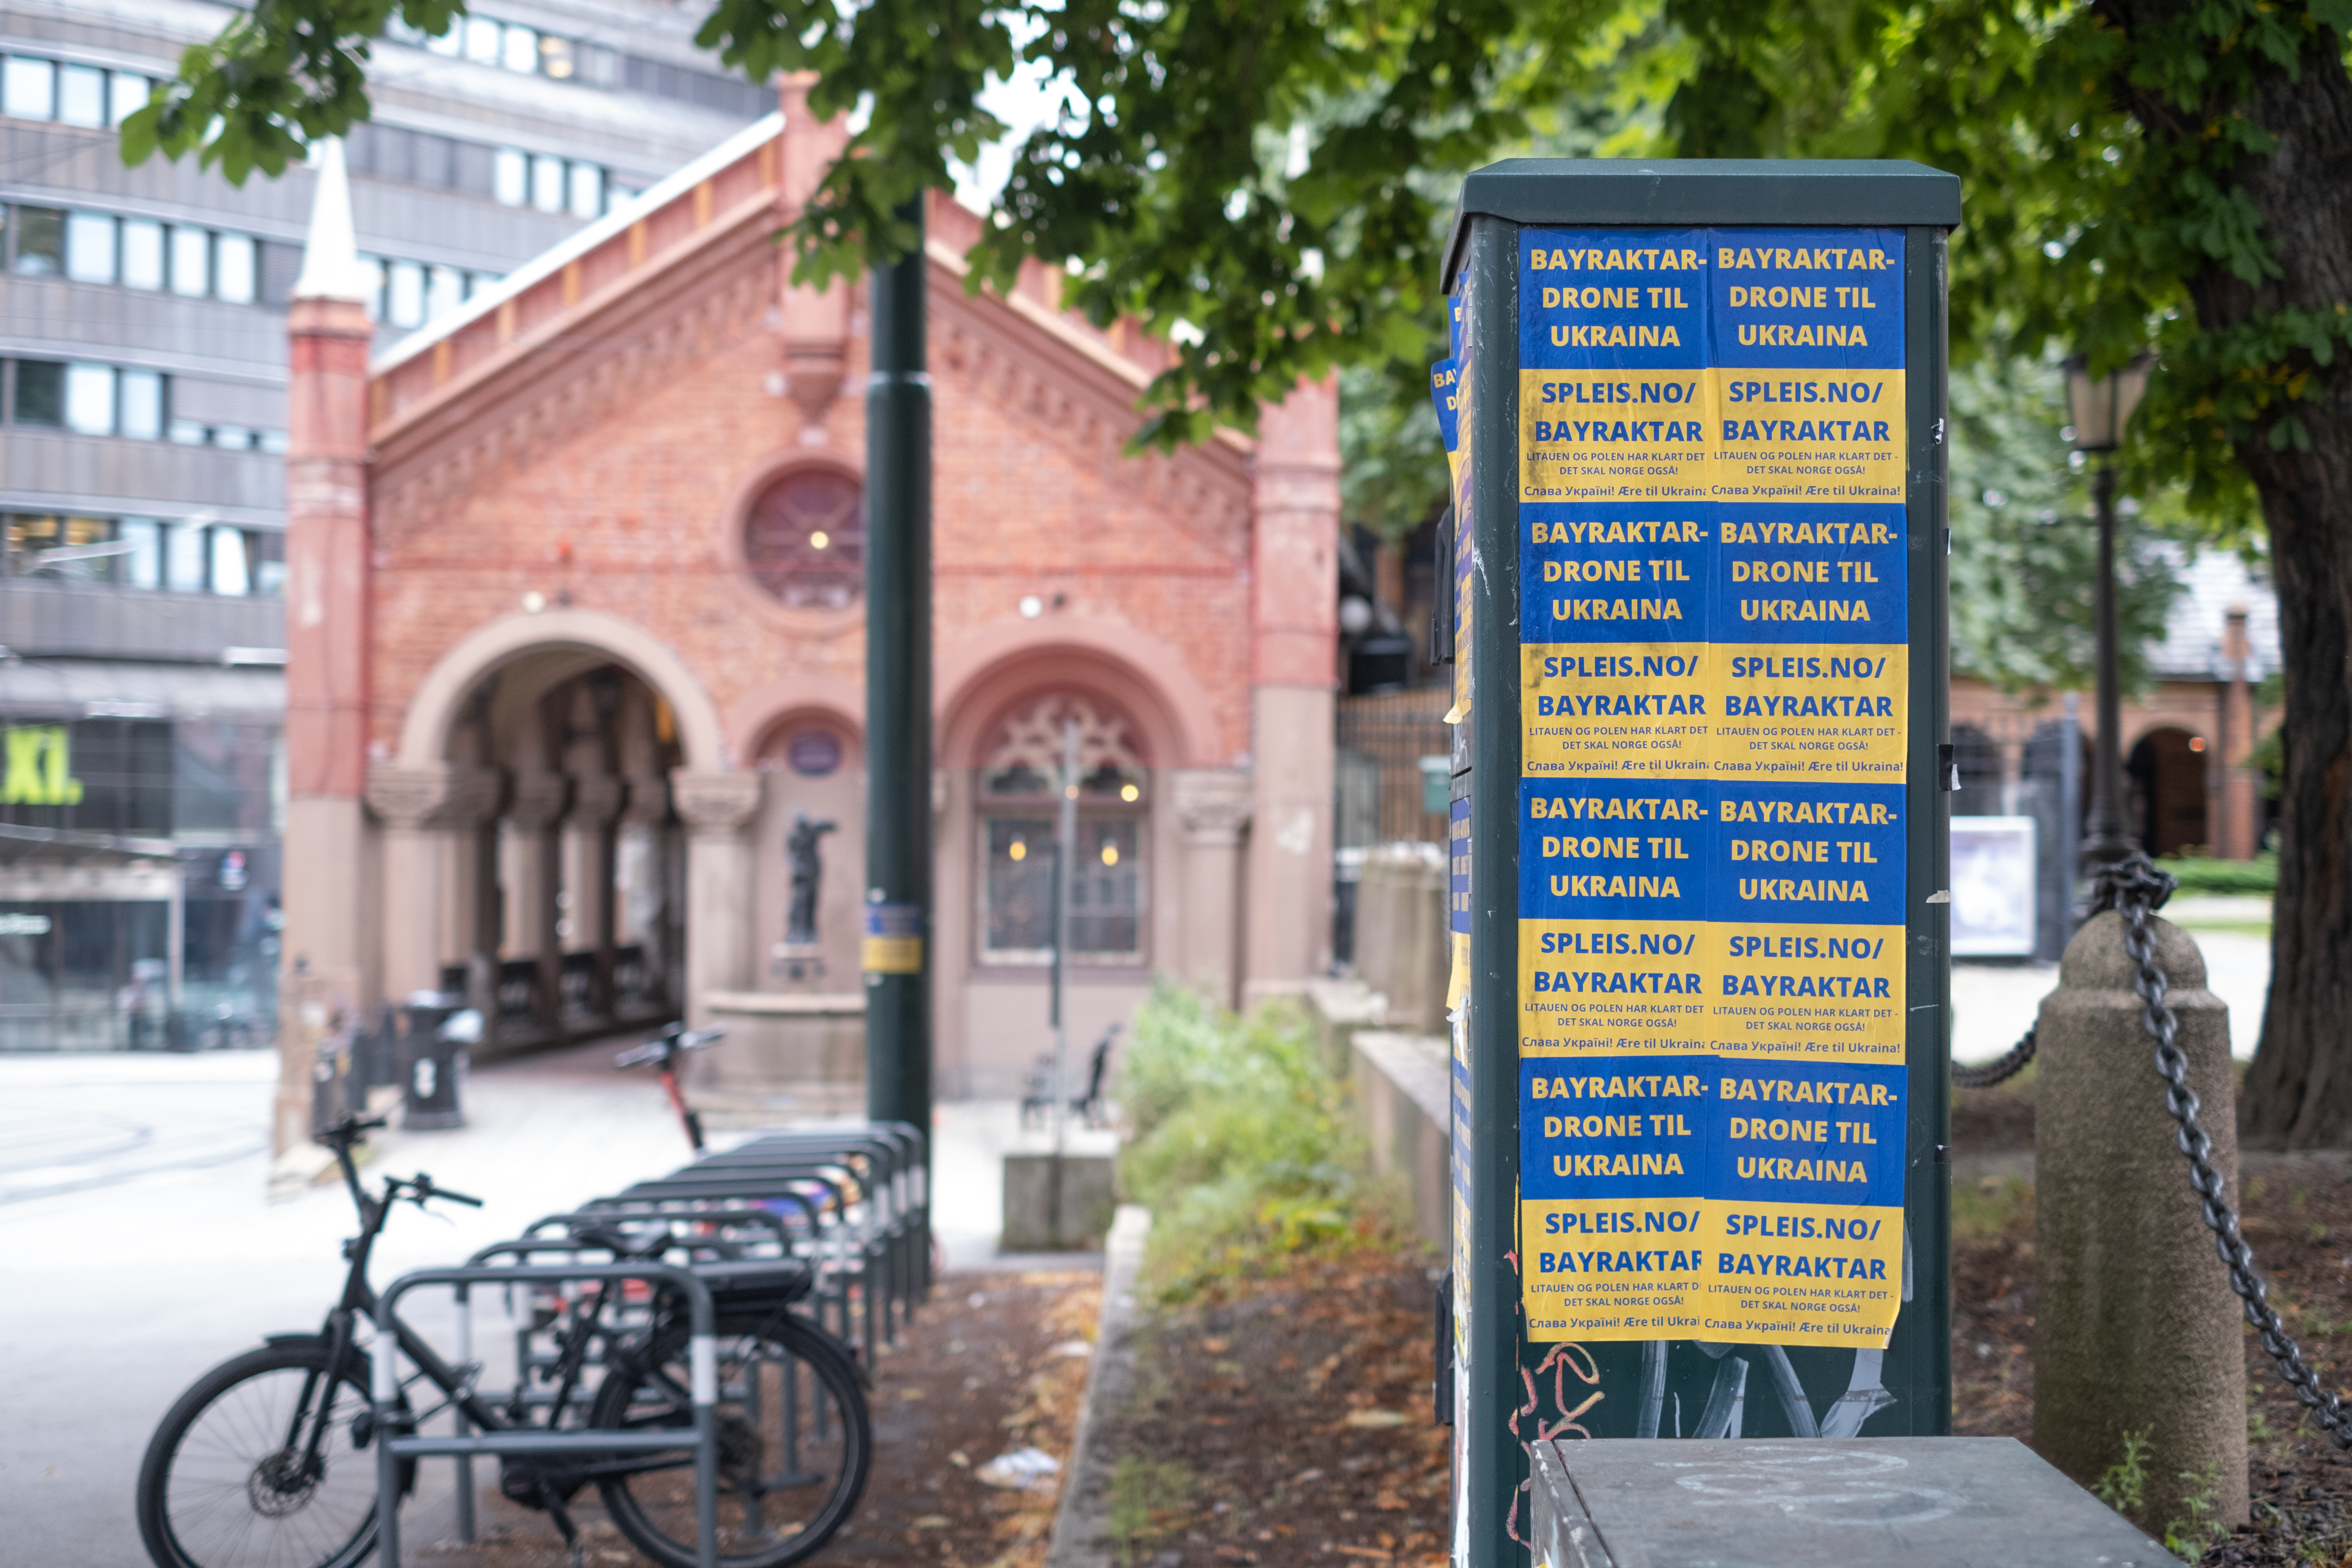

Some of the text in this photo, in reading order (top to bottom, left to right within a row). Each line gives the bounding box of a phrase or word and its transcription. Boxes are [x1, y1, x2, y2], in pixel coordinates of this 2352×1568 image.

[1531, 250, 1707, 270] BAYRAKTAR-
[1719, 248, 1894, 269] BAYRAKTAR-
[1543, 287, 1688, 308] DRONE TIL
[1730, 287, 1875, 307] DRONE TIL
[1551, 326, 1680, 346] UKRAINA
[1739, 325, 1867, 346] UKRAINA
[1543, 383, 1695, 403] SPLEIS.NO/
[1730, 382, 1883, 402] SPLEIS.NO/
[1536, 422, 1703, 441] BAYRAKTAR
[1724, 421, 1890, 441] BAYRAKTAR
[1648, 466, 1678, 474] OGSÅ!
[1835, 466, 1865, 474] OGSÅ!
[1712, 485, 1900, 497] Слава Україні! Ære til Ukraina!
[1532, 522, 1708, 543] BAYRAKTAR-
[1721, 523, 1897, 544] BAYRAKTAR-
[1544, 560, 1689, 582] DRONE TIL
[1733, 561, 1878, 582] DRONE TIL
[1553, 599, 1682, 620] UKRAINA
[1741, 600, 1870, 621] UKRAINA
[1545, 656, 1698, 677] SPLEIS.NO/
[1733, 657, 1885, 678] SPLEIS.NO/
[1539, 695, 1705, 716] BAYRAKTAR
[1726, 696, 1893, 716] BAYRAKTAR
[1651, 739, 1681, 749] OGSÅ!
[1838, 741, 1868, 750] OGSÅ!
[1714, 761, 1903, 773] Слава Україні! Ære til Ukraina!
[1531, 798, 1708, 820] BAYRAKTAR-
[1721, 801, 1897, 824] BAYRAKTAR-
[1543, 836, 1688, 859] DRONE TIL
[1732, 840, 1877, 863] DRONE TIL
[1551, 876, 1680, 897] UKRAINA
[1740, 879, 1868, 901] UKRAINA
[1542, 933, 1695, 954] SPLEIS.NO/
[1730, 936, 1883, 959] SPLEIS.NO/
[1535, 972, 1702, 993] BAYRAKTAR
[1723, 975, 1890, 997] BAYRAKTAR
[1646, 1018, 1676, 1027] OGSÅ!
[1835, 1022, 1865, 1031] OGSÅ!
[1710, 1041, 1900, 1053] Слава Україні! Ære til Ukraina!
[1532, 1076, 1708, 1099] BAYRAKTAR-
[1720, 1078, 1897, 1105] BAYRAKTAR-
[1545, 1115, 1691, 1137] DRONE TIL
[1730, 1118, 1876, 1144] DRONE TIL
[1554, 1154, 1683, 1176] UKRAINA
[1738, 1157, 1867, 1182] UKRAINA
[1546, 1211, 1699, 1233] SPLEIS.NO/
[1727, 1214, 1880, 1240] SPLEIS.NO/
[1719, 1253, 1885, 1279] BAYRAKTAR
[1653, 1296, 1683, 1305] OGSÅ!
[1709, 1285, 1751, 1294] LITAUEN
[1755, 1286, 1769, 1295] OG
[1773, 1287, 1806, 1296] POLEN
[1791, 1302, 1825, 1311] NORGE
[1830, 1303, 1860, 1312] OGSÅ!
[1705, 1318, 1742, 1329] Слава
[1746, 1321, 1795, 1333] Україні!
[1800, 1323, 1823, 1332] Ære
[1828, 1324, 1839, 1333] til
